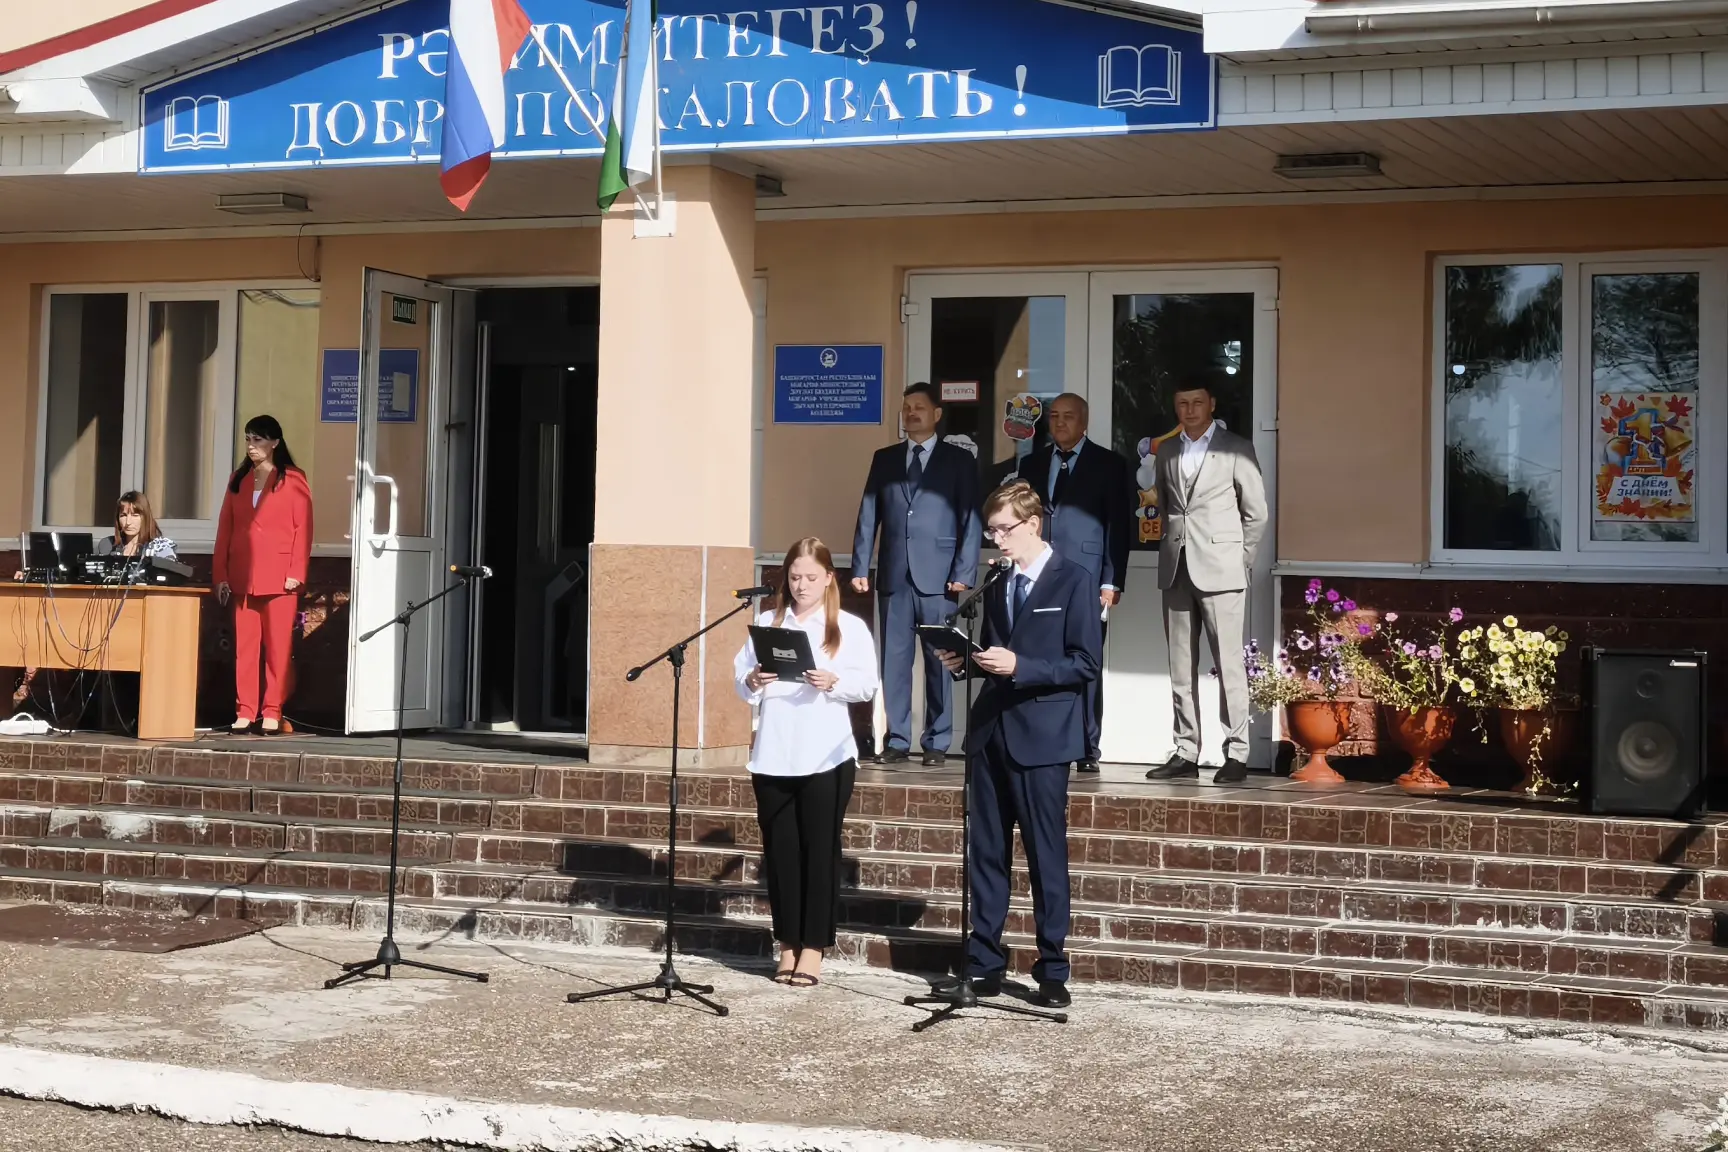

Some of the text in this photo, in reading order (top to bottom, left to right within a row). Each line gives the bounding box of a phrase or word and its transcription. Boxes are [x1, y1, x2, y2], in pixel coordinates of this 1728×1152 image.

[377, 20, 616, 79] РӘИМ
[285, 98, 444, 159] ДОБР
[1620, 477, 1669, 488] С ДНЁМ
